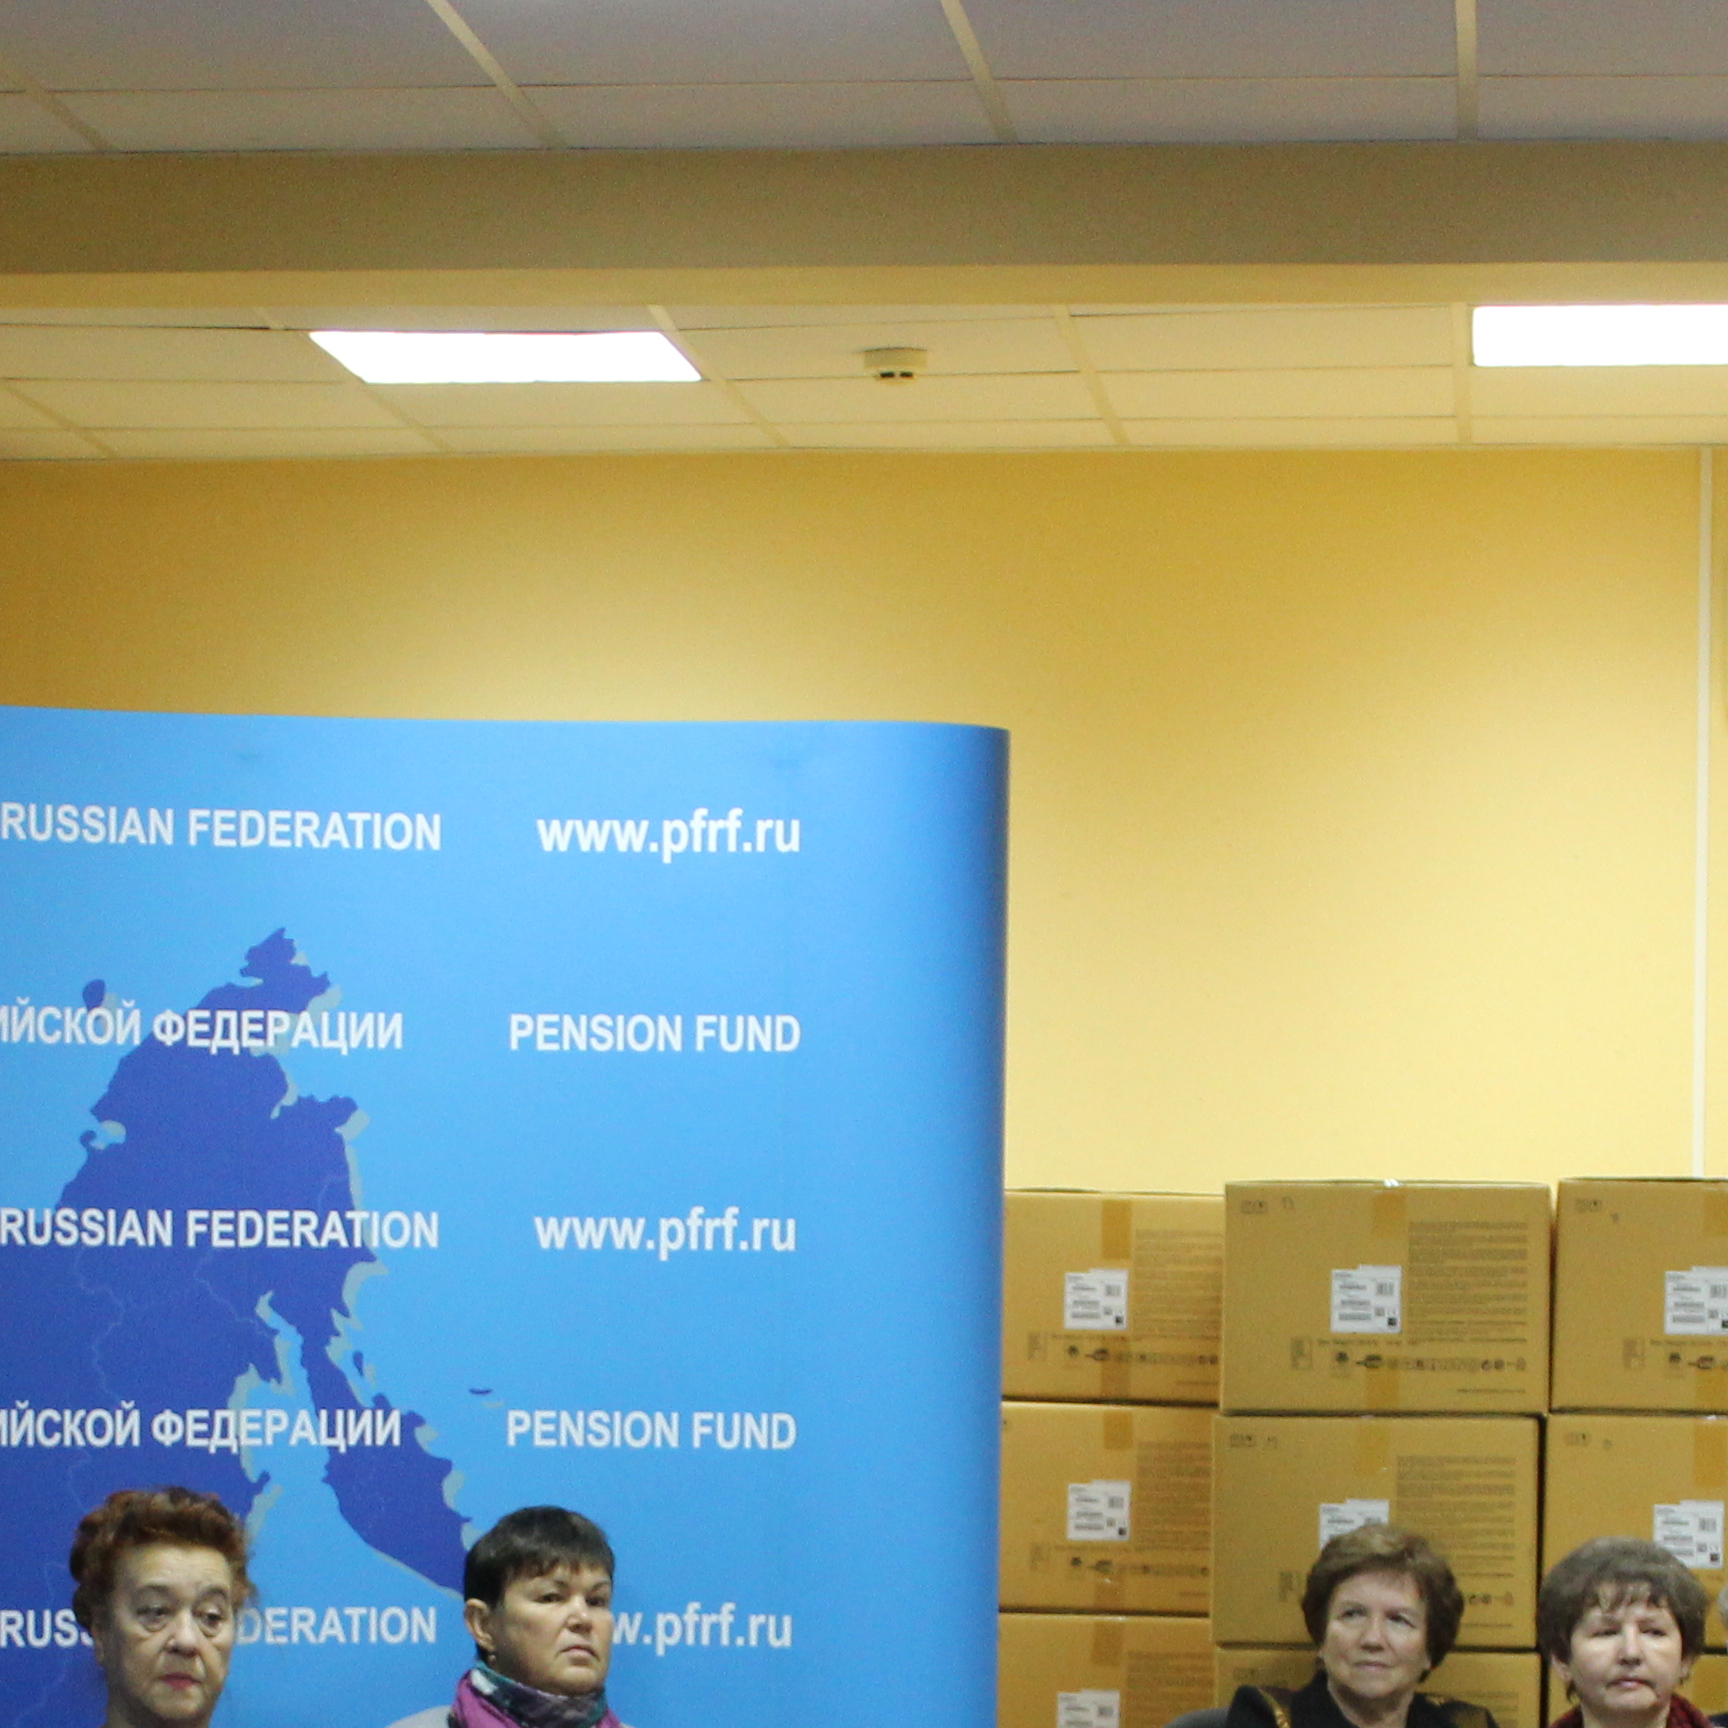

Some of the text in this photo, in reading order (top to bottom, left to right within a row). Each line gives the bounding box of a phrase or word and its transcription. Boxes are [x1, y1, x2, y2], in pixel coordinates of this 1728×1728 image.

[0, 801, 175, 846] RUSSIAN
[188, 808, 442, 851] FEDERATION
[536, 806, 801, 864] www.pfrf.ru
[152, 1007, 404, 1057] ФЕДЕРАЦИИ
[509, 1013, 801, 1053] PENSION FUND
[0, 1206, 173, 1247] RUSSIAN
[186, 1207, 440, 1250] FEDERATION
[533, 1205, 796, 1262] www.pfrf.ru
[151, 1406, 401, 1454] ФЕДЕРАЦИИ
[506, 1409, 797, 1450] PENSION FUND
[235, 1606, 437, 1645] DERATION
[611, 1601, 793, 1657] w.pfrf.ru
